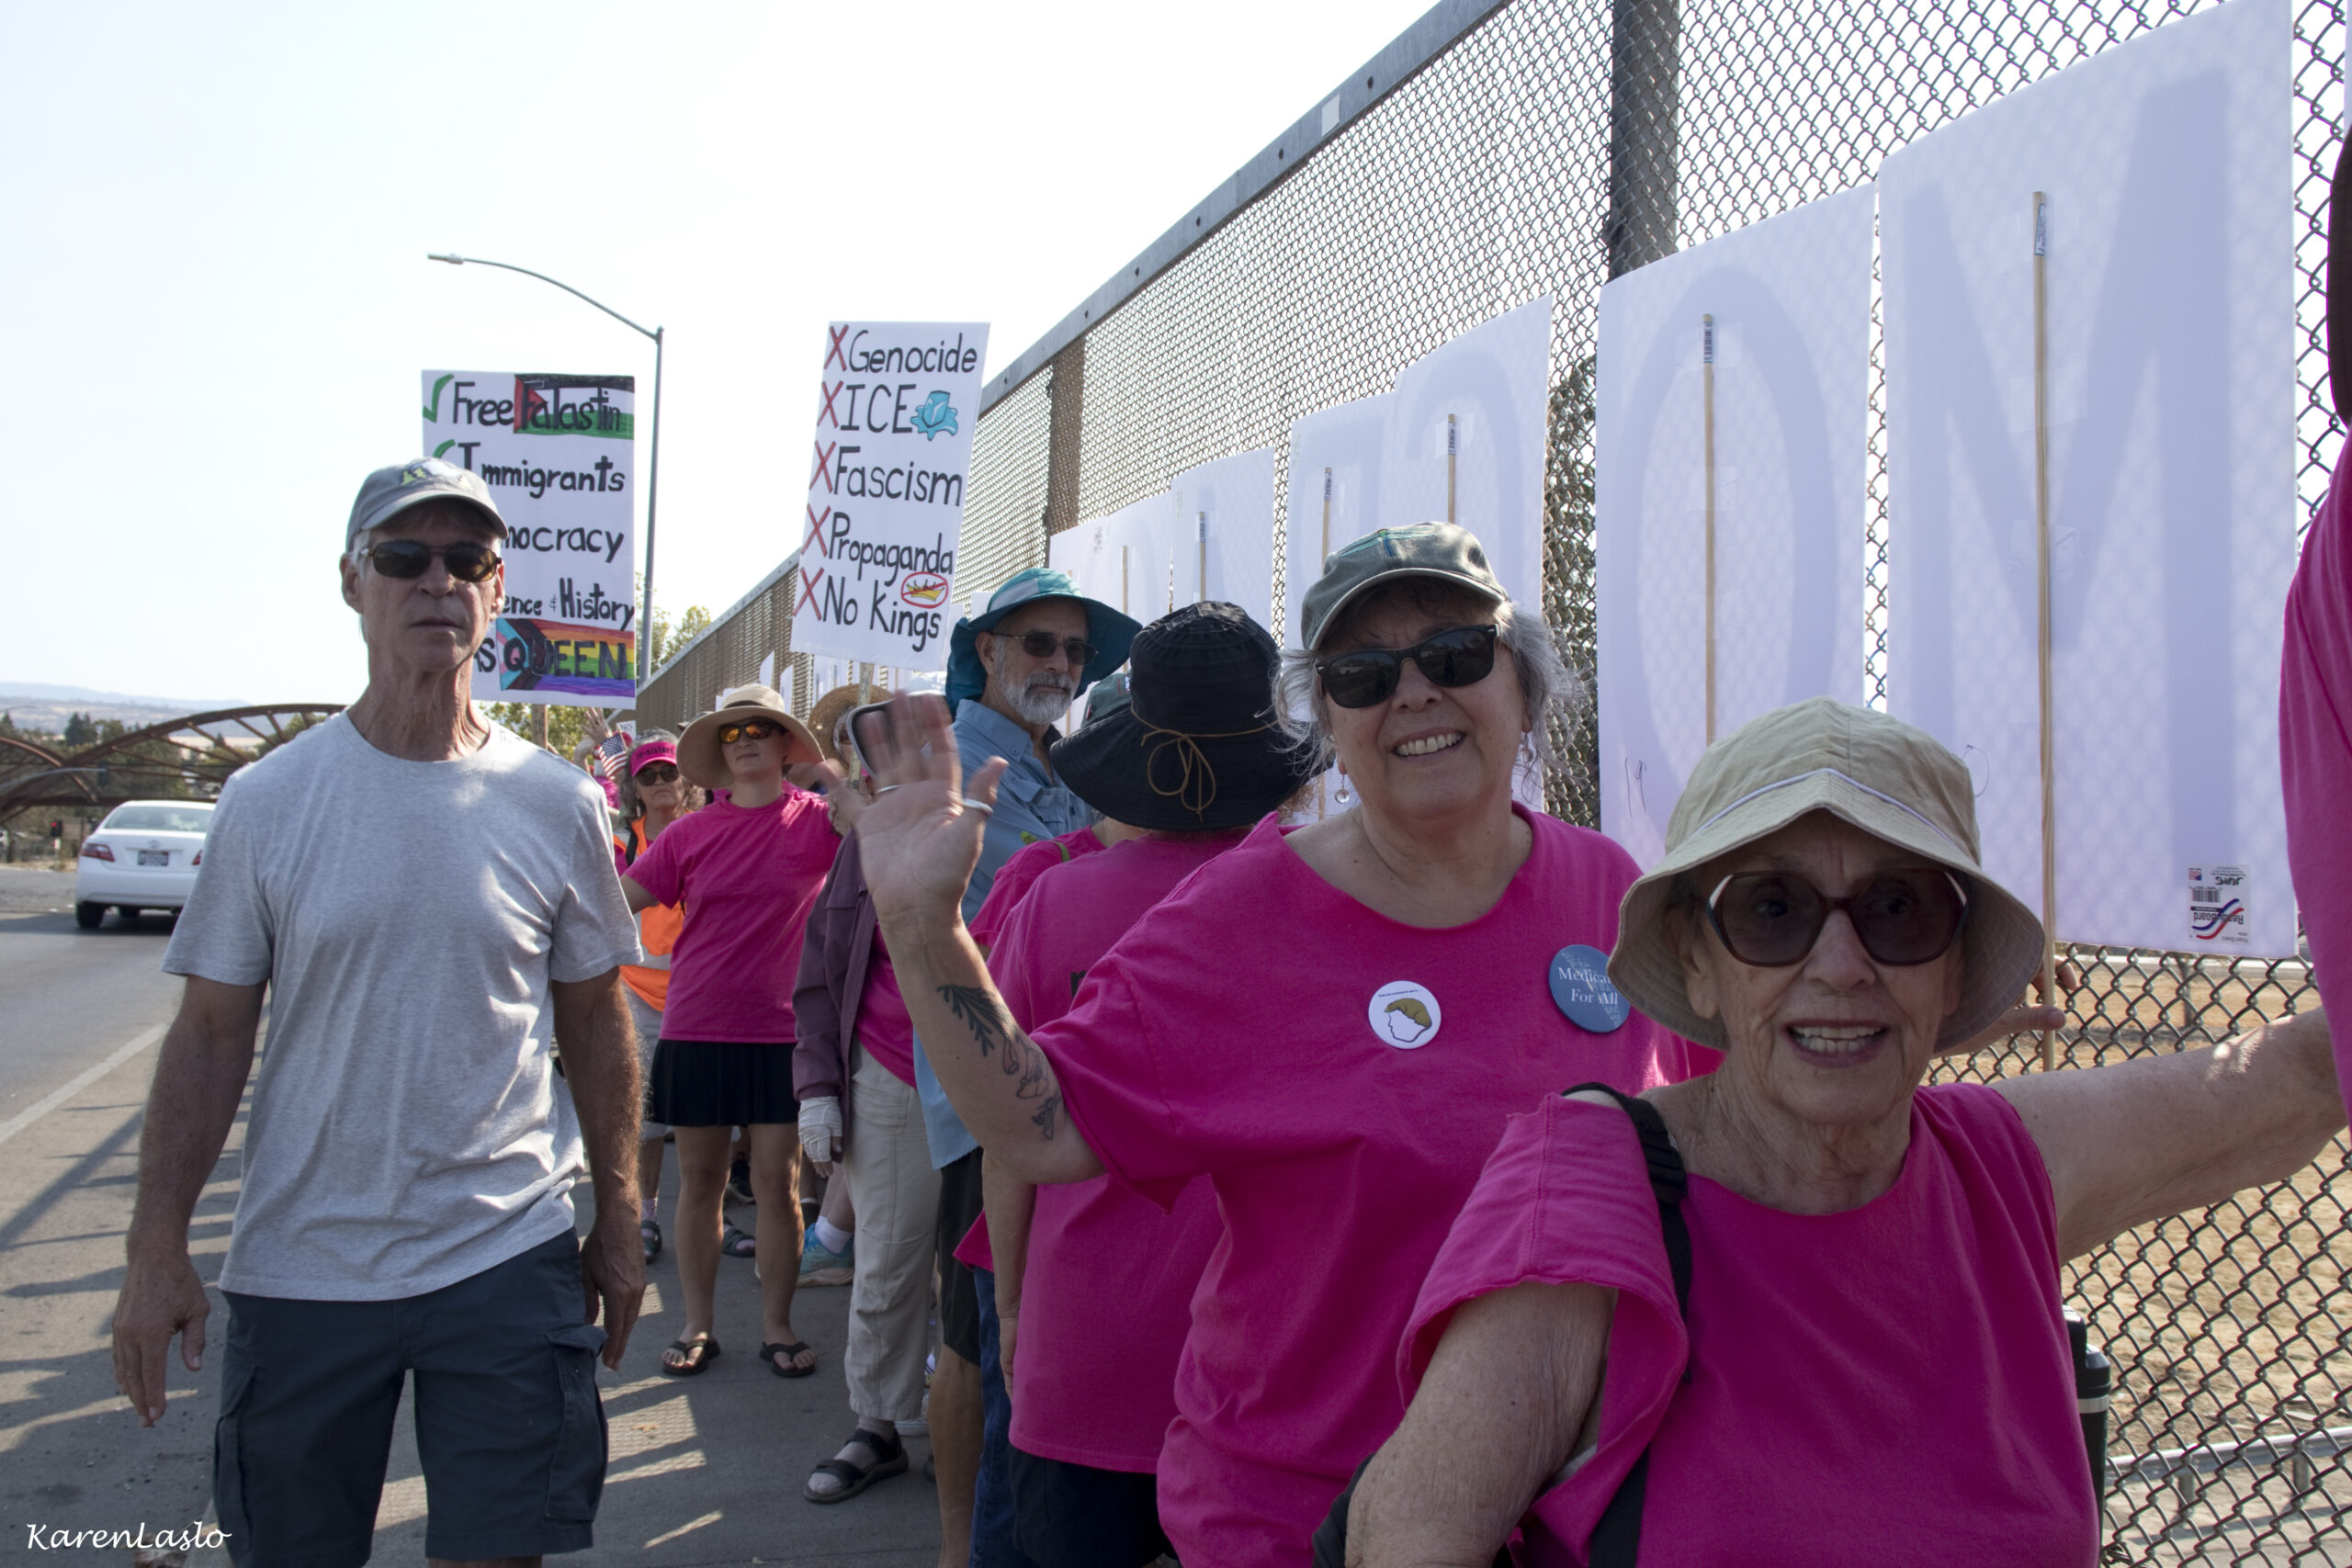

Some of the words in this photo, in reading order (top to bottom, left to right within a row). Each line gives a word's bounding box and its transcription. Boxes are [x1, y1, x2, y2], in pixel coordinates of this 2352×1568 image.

[848, 330, 978, 374] Genocide
[453, 381, 514, 426] Free
[521, 379, 621, 431] Falastin
[840, 383, 917, 434] ICE
[458, 442, 626, 499] Immigrants
[834, 446, 963, 506] Fascism
[828, 512, 953, 587] Propaganda
[503, 594, 543, 616] ence
[559, 577, 635, 631] History
[823, 575, 858, 626] No
[870, 579, 942, 652] Kings
[504, 636, 628, 681] QUEEN
[1571, 987, 1594, 1003] For
[1598, 991, 1618, 1005] All
